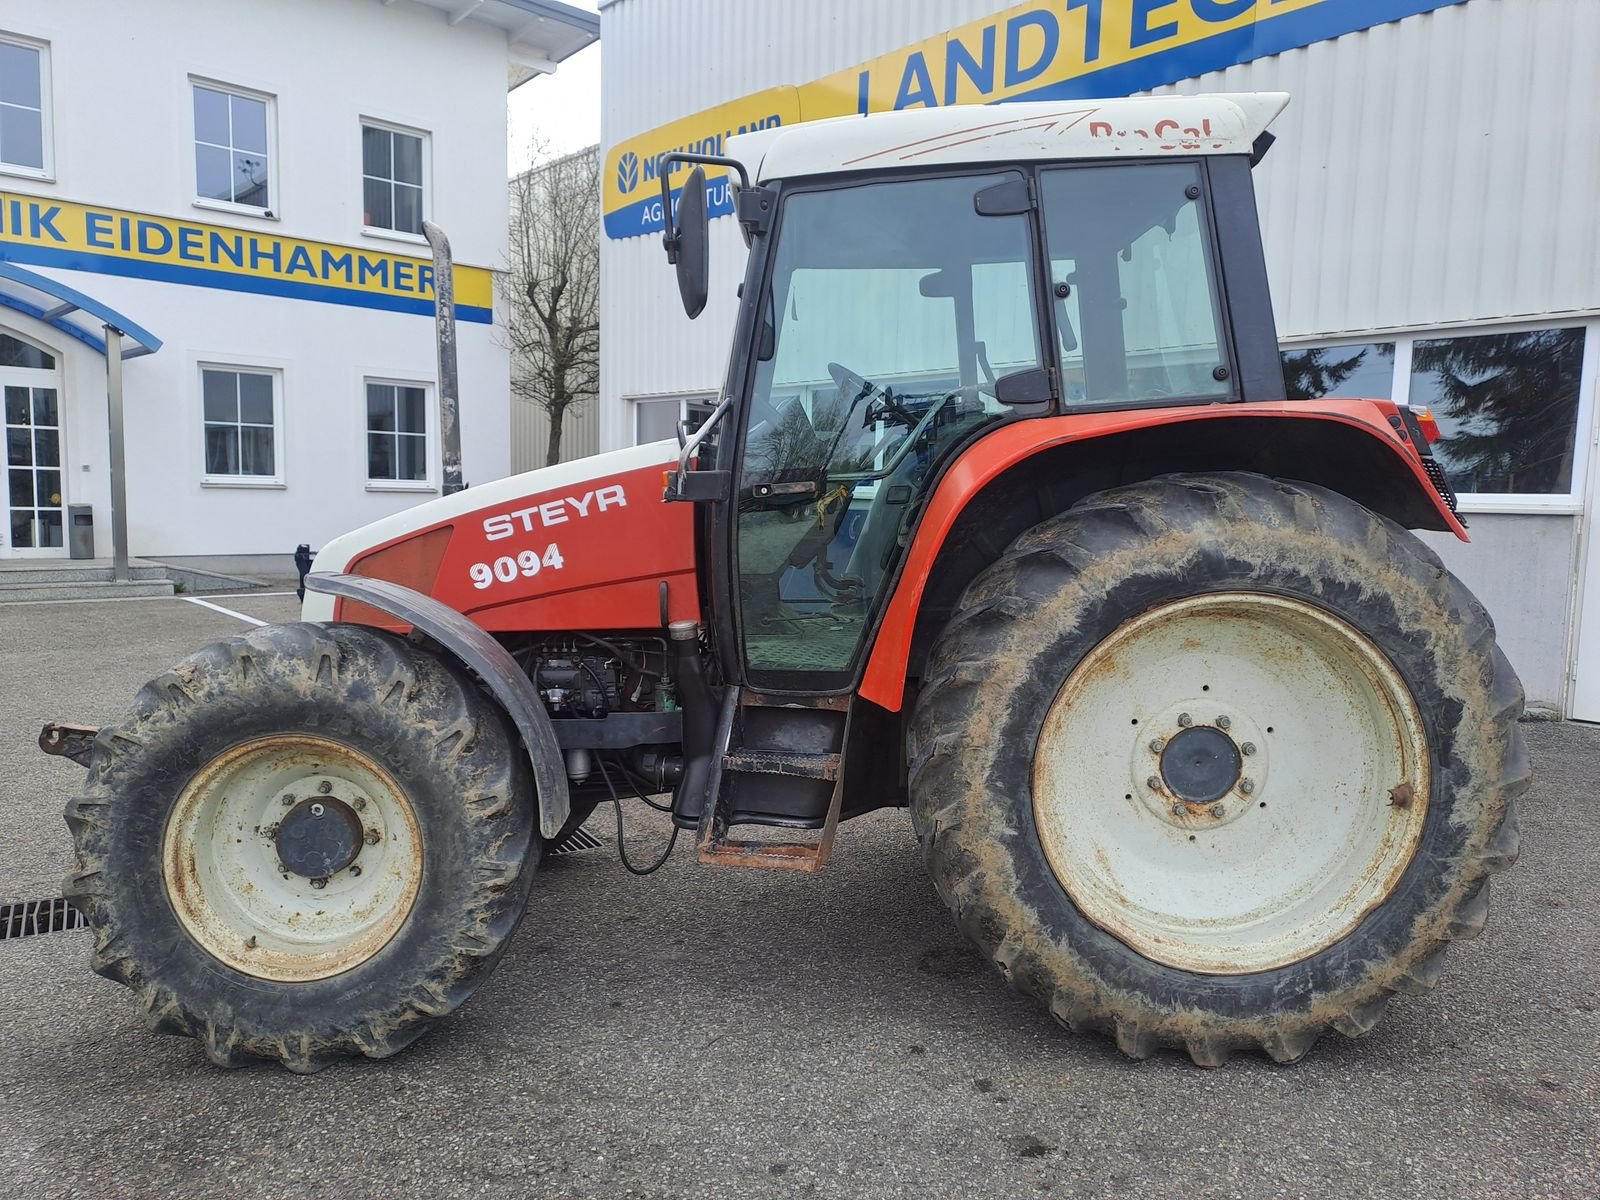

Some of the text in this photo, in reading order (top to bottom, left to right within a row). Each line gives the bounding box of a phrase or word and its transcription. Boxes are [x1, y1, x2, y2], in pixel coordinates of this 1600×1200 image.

[0, 198, 435, 294] IK EIDENHAMMER
[483, 484, 627, 541] STEYR
[469, 543, 564, 590] 9094
